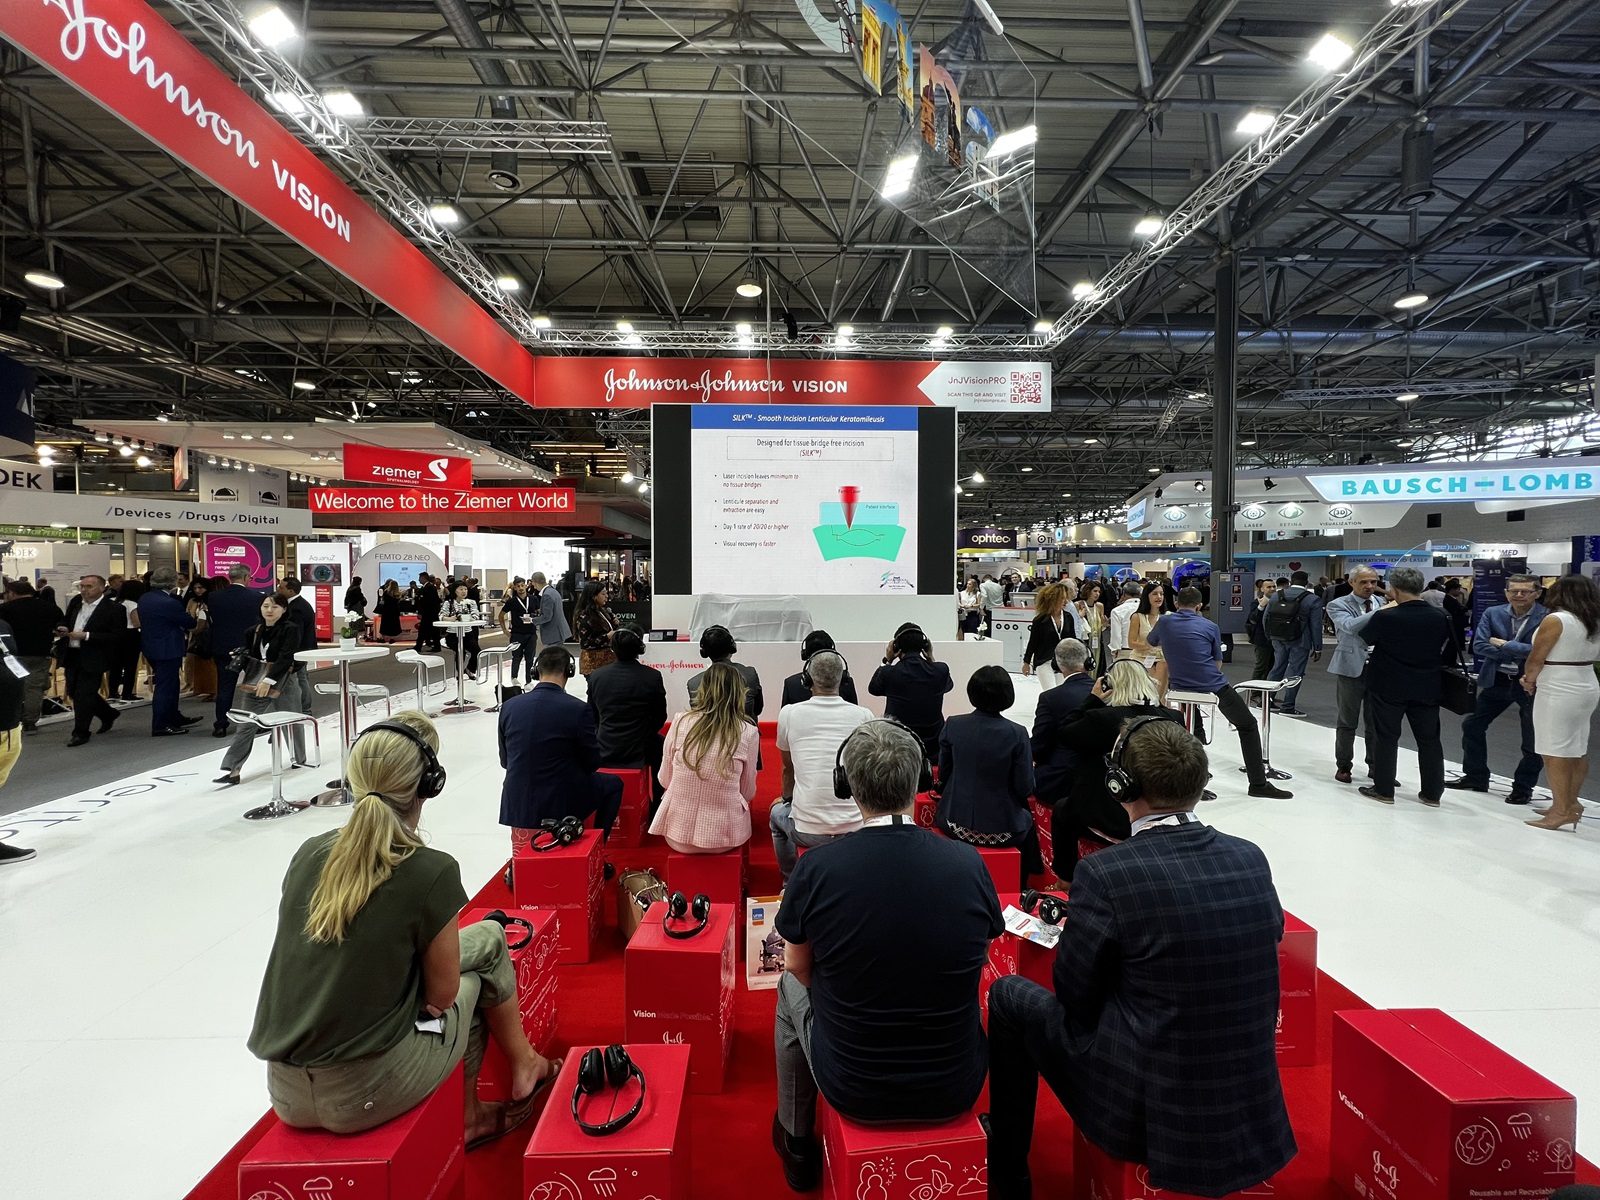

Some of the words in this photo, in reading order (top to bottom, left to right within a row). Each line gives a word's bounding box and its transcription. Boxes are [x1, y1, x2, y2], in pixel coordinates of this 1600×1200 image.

[272, 160, 350, 242] VISION
[792, 380, 848, 393] VISION
[807, 415, 839, 423] Lenticular
[839, 415, 885, 423] Keratomileusis
[756, 438, 783, 448] Designed
[784, 438, 792, 447] for
[830, 438, 842, 447] free
[842, 438, 865, 447] incision
[372, 465, 422, 479] ziemer
[1342, 476, 1467, 496] BAUSCH
[1502, 473, 1593, 491] LOMB
[314, 491, 395, 510] Welcome
[398, 493, 417, 509] to
[422, 492, 449, 509] the
[454, 491, 513, 508] Ziemer
[518, 492, 568, 509] World
[773, 523, 789, 531] higher
[971, 533, 1011, 544] ophtec
[414, 553, 431, 561] NEO
[633, 1010, 657, 1018] Vision
[1338, 1090, 1364, 1119] Vision
[1470, 1189, 1501, 1197] Reusable
